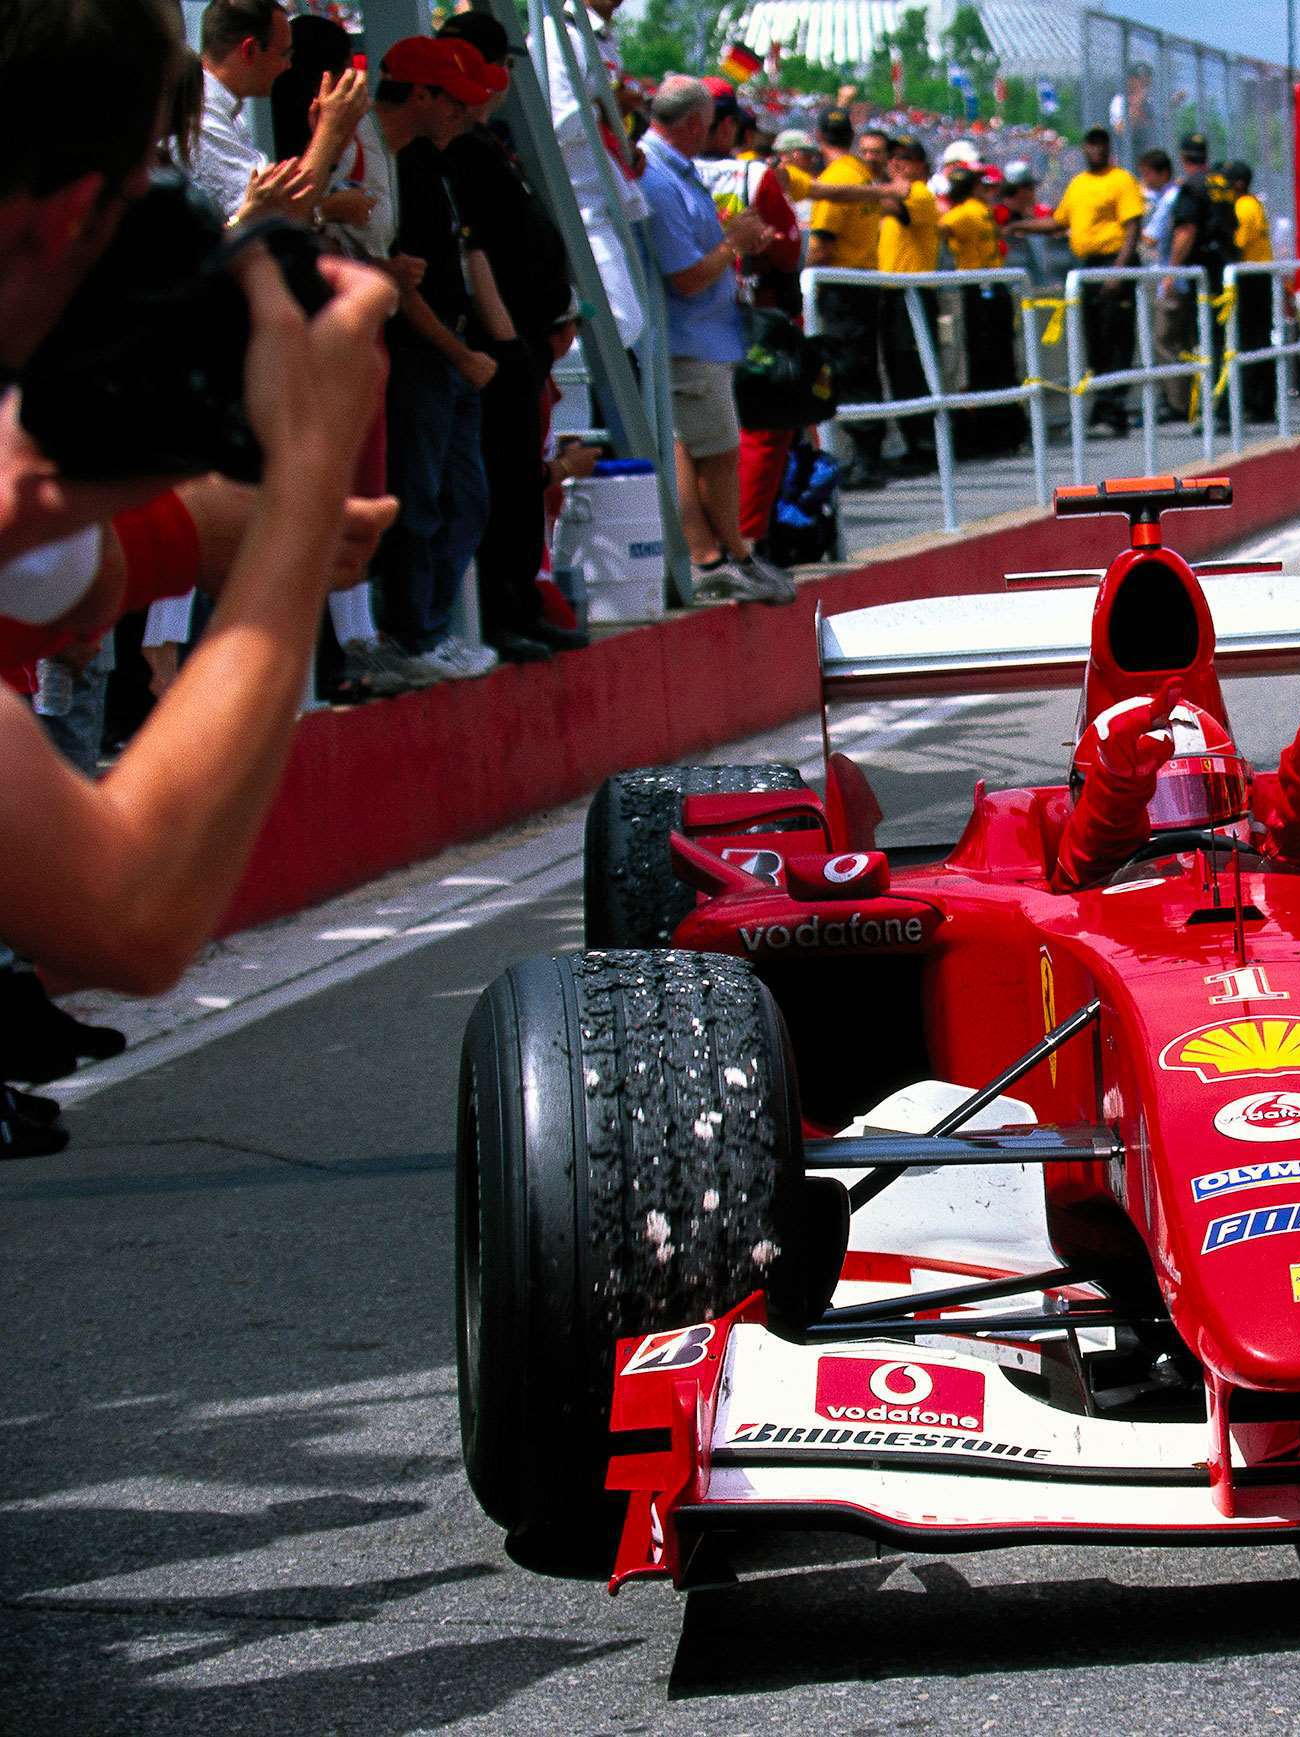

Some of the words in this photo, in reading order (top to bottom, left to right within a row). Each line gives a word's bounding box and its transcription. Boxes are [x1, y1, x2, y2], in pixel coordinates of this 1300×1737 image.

[738, 912, 923, 951] vodafone
[1203, 966, 1290, 1005] 1
[825, 1404, 979, 1429] vodafone
[724, 1422, 1052, 1461] BRIDGESTONE
